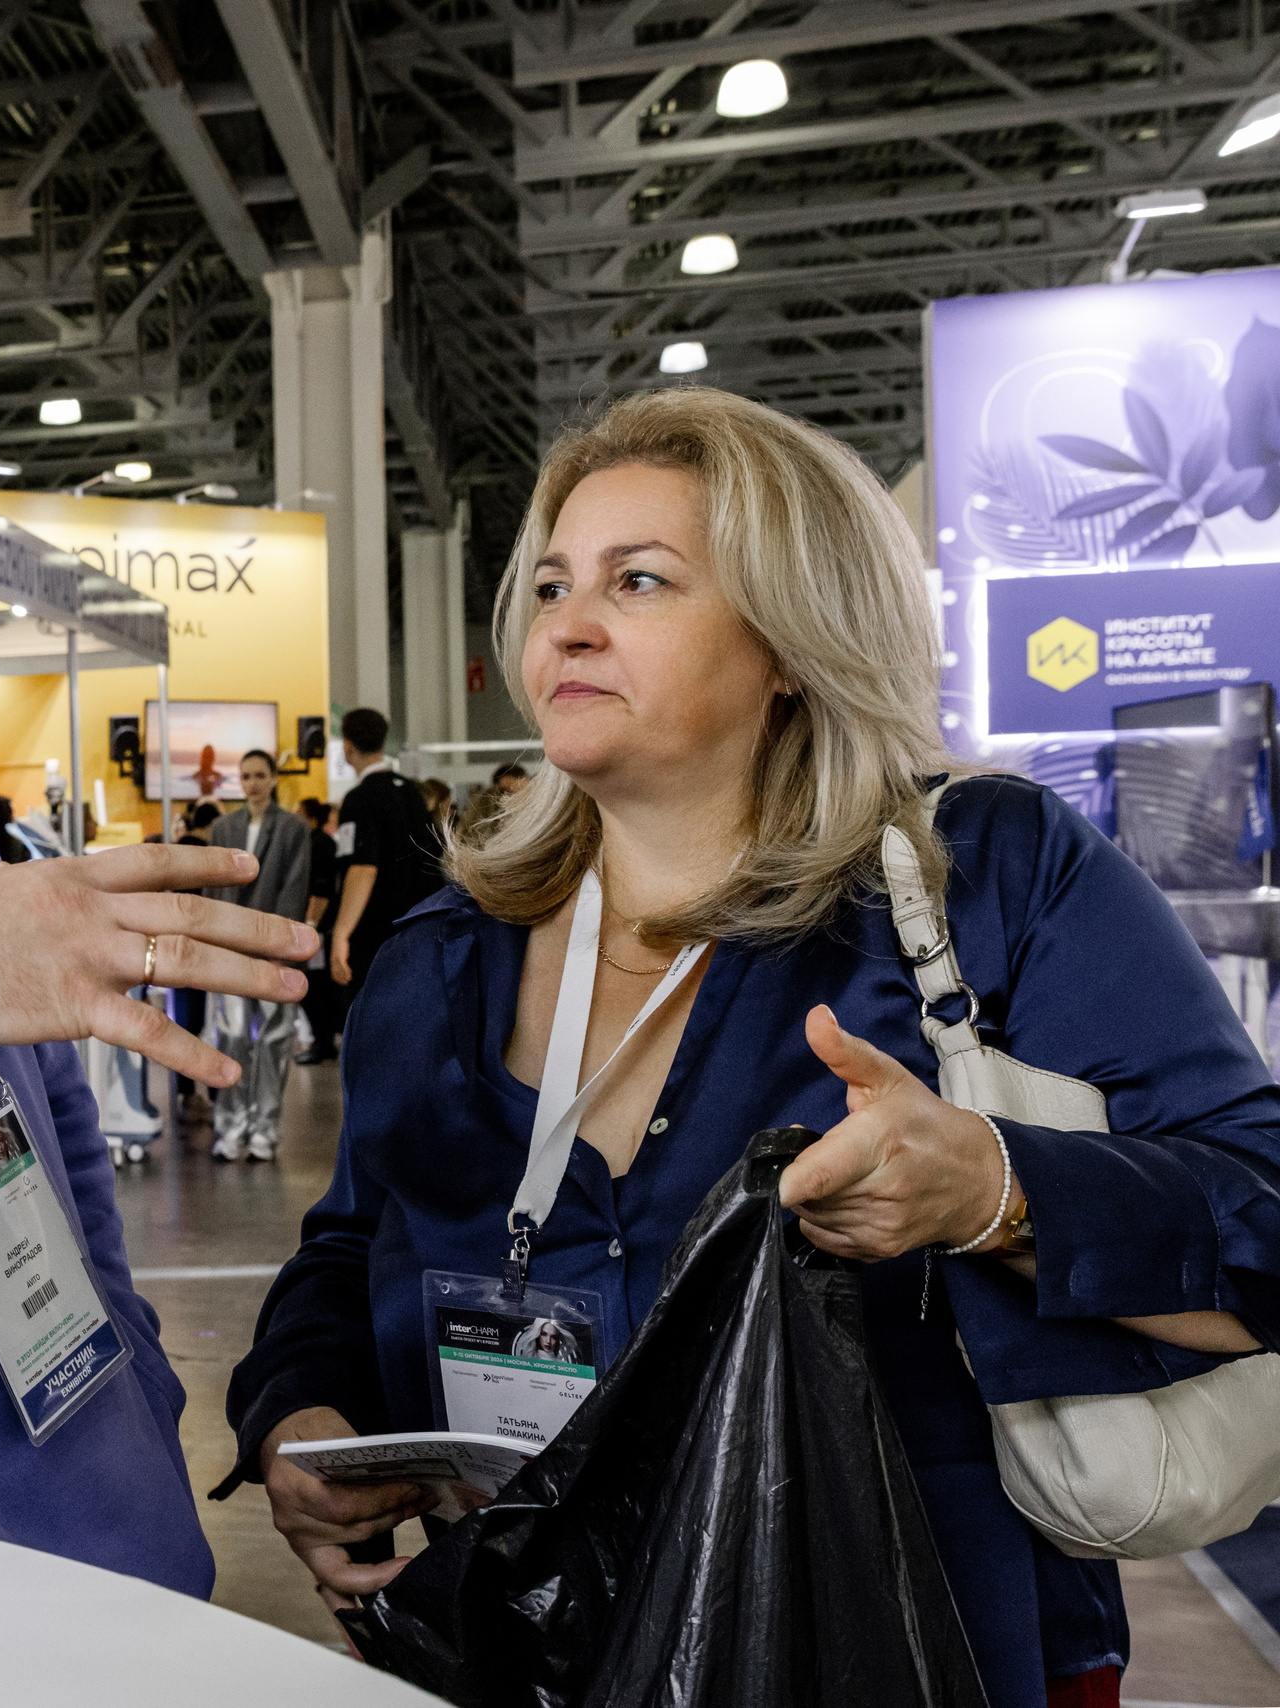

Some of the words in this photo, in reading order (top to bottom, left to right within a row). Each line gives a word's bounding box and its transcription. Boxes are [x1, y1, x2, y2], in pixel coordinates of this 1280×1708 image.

[1104, 613, 1214, 635] ИНСТИТУТ
[1104, 631, 1204, 652] КРАСОТЫ
[1104, 652, 1136, 669] НА
[1137, 647, 1216, 667] АРБАТЕ
[7, 1236, 30, 1261] АНДРЕЙ
[4, 1243, 43, 1279] ВИНОГРАДОВ
[450, 1321, 499, 1338] interCHARM
[44, 1342, 97, 1396] УЧАСТНИК
[60, 1365, 93, 1398] EXHIBITOR
[559, 1391, 584, 1399] GELTEK
[497, 1415, 540, 1430] ТАТЬЯНА
[496, 1426, 547, 1443] ЛОМАКИНА
